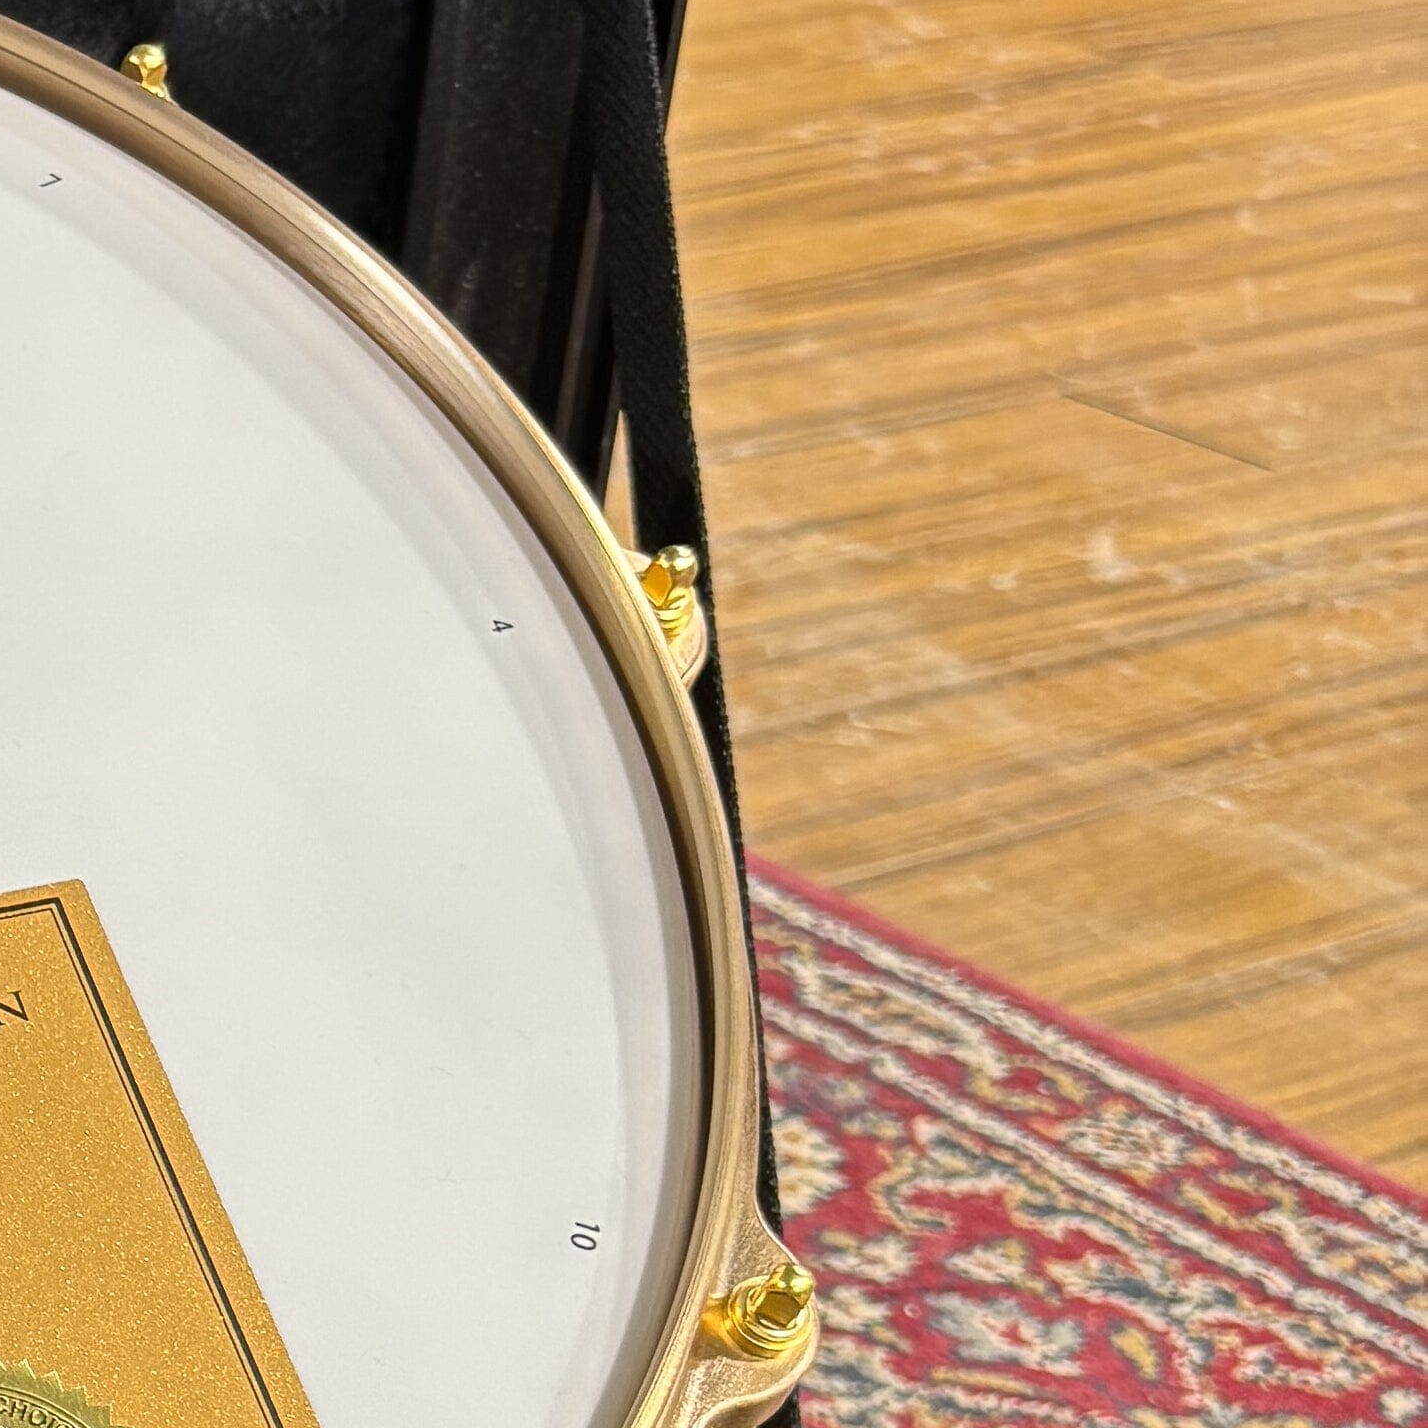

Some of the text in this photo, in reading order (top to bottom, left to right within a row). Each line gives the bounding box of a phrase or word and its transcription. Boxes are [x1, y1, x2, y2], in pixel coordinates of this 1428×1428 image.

[39, 172, 63, 188] 7
[491, 619, 515, 633] 4
[569, 1221, 601, 1251] 10
